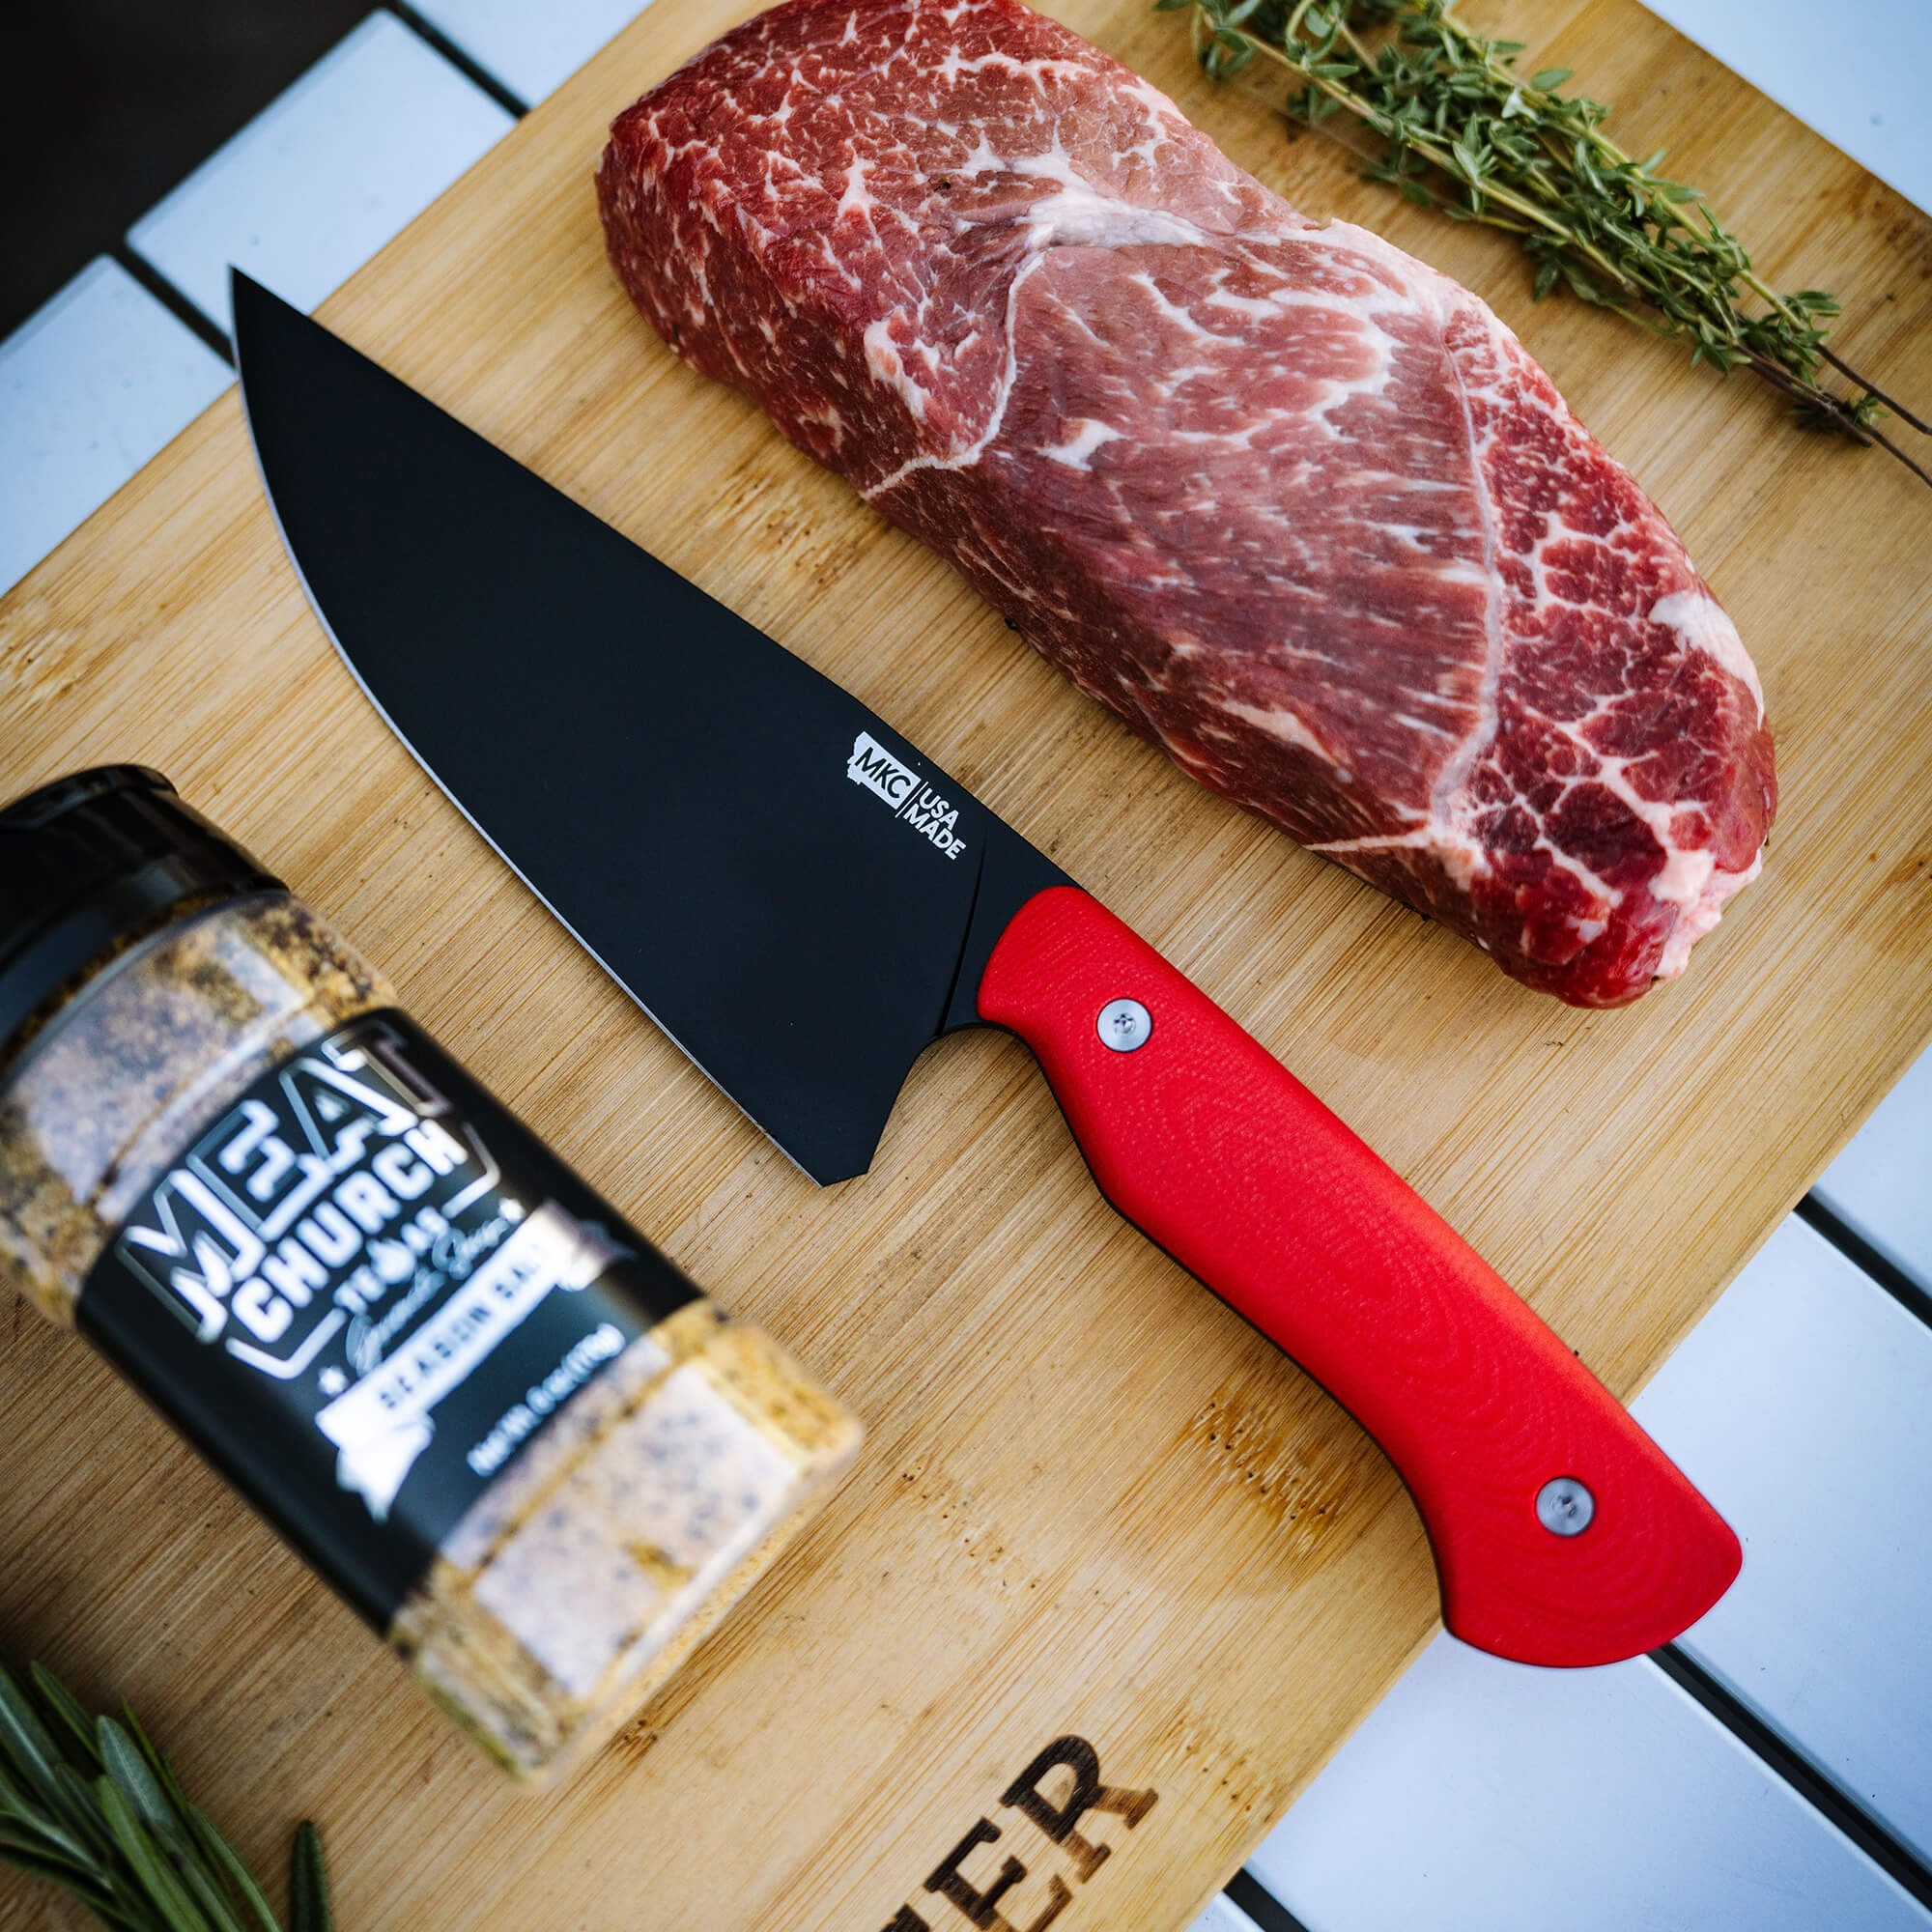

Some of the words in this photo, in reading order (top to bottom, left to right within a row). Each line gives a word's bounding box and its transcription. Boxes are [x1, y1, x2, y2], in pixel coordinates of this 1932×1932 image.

[855, 747, 911, 799] MKC
[903, 803, 966, 860] MADE
[919, 787, 959, 831] USA
[117, 1018, 452, 1343] MEAT
[231, 1119, 469, 1344] CHURCH
[877, 1735, 1159, 1932] ER
